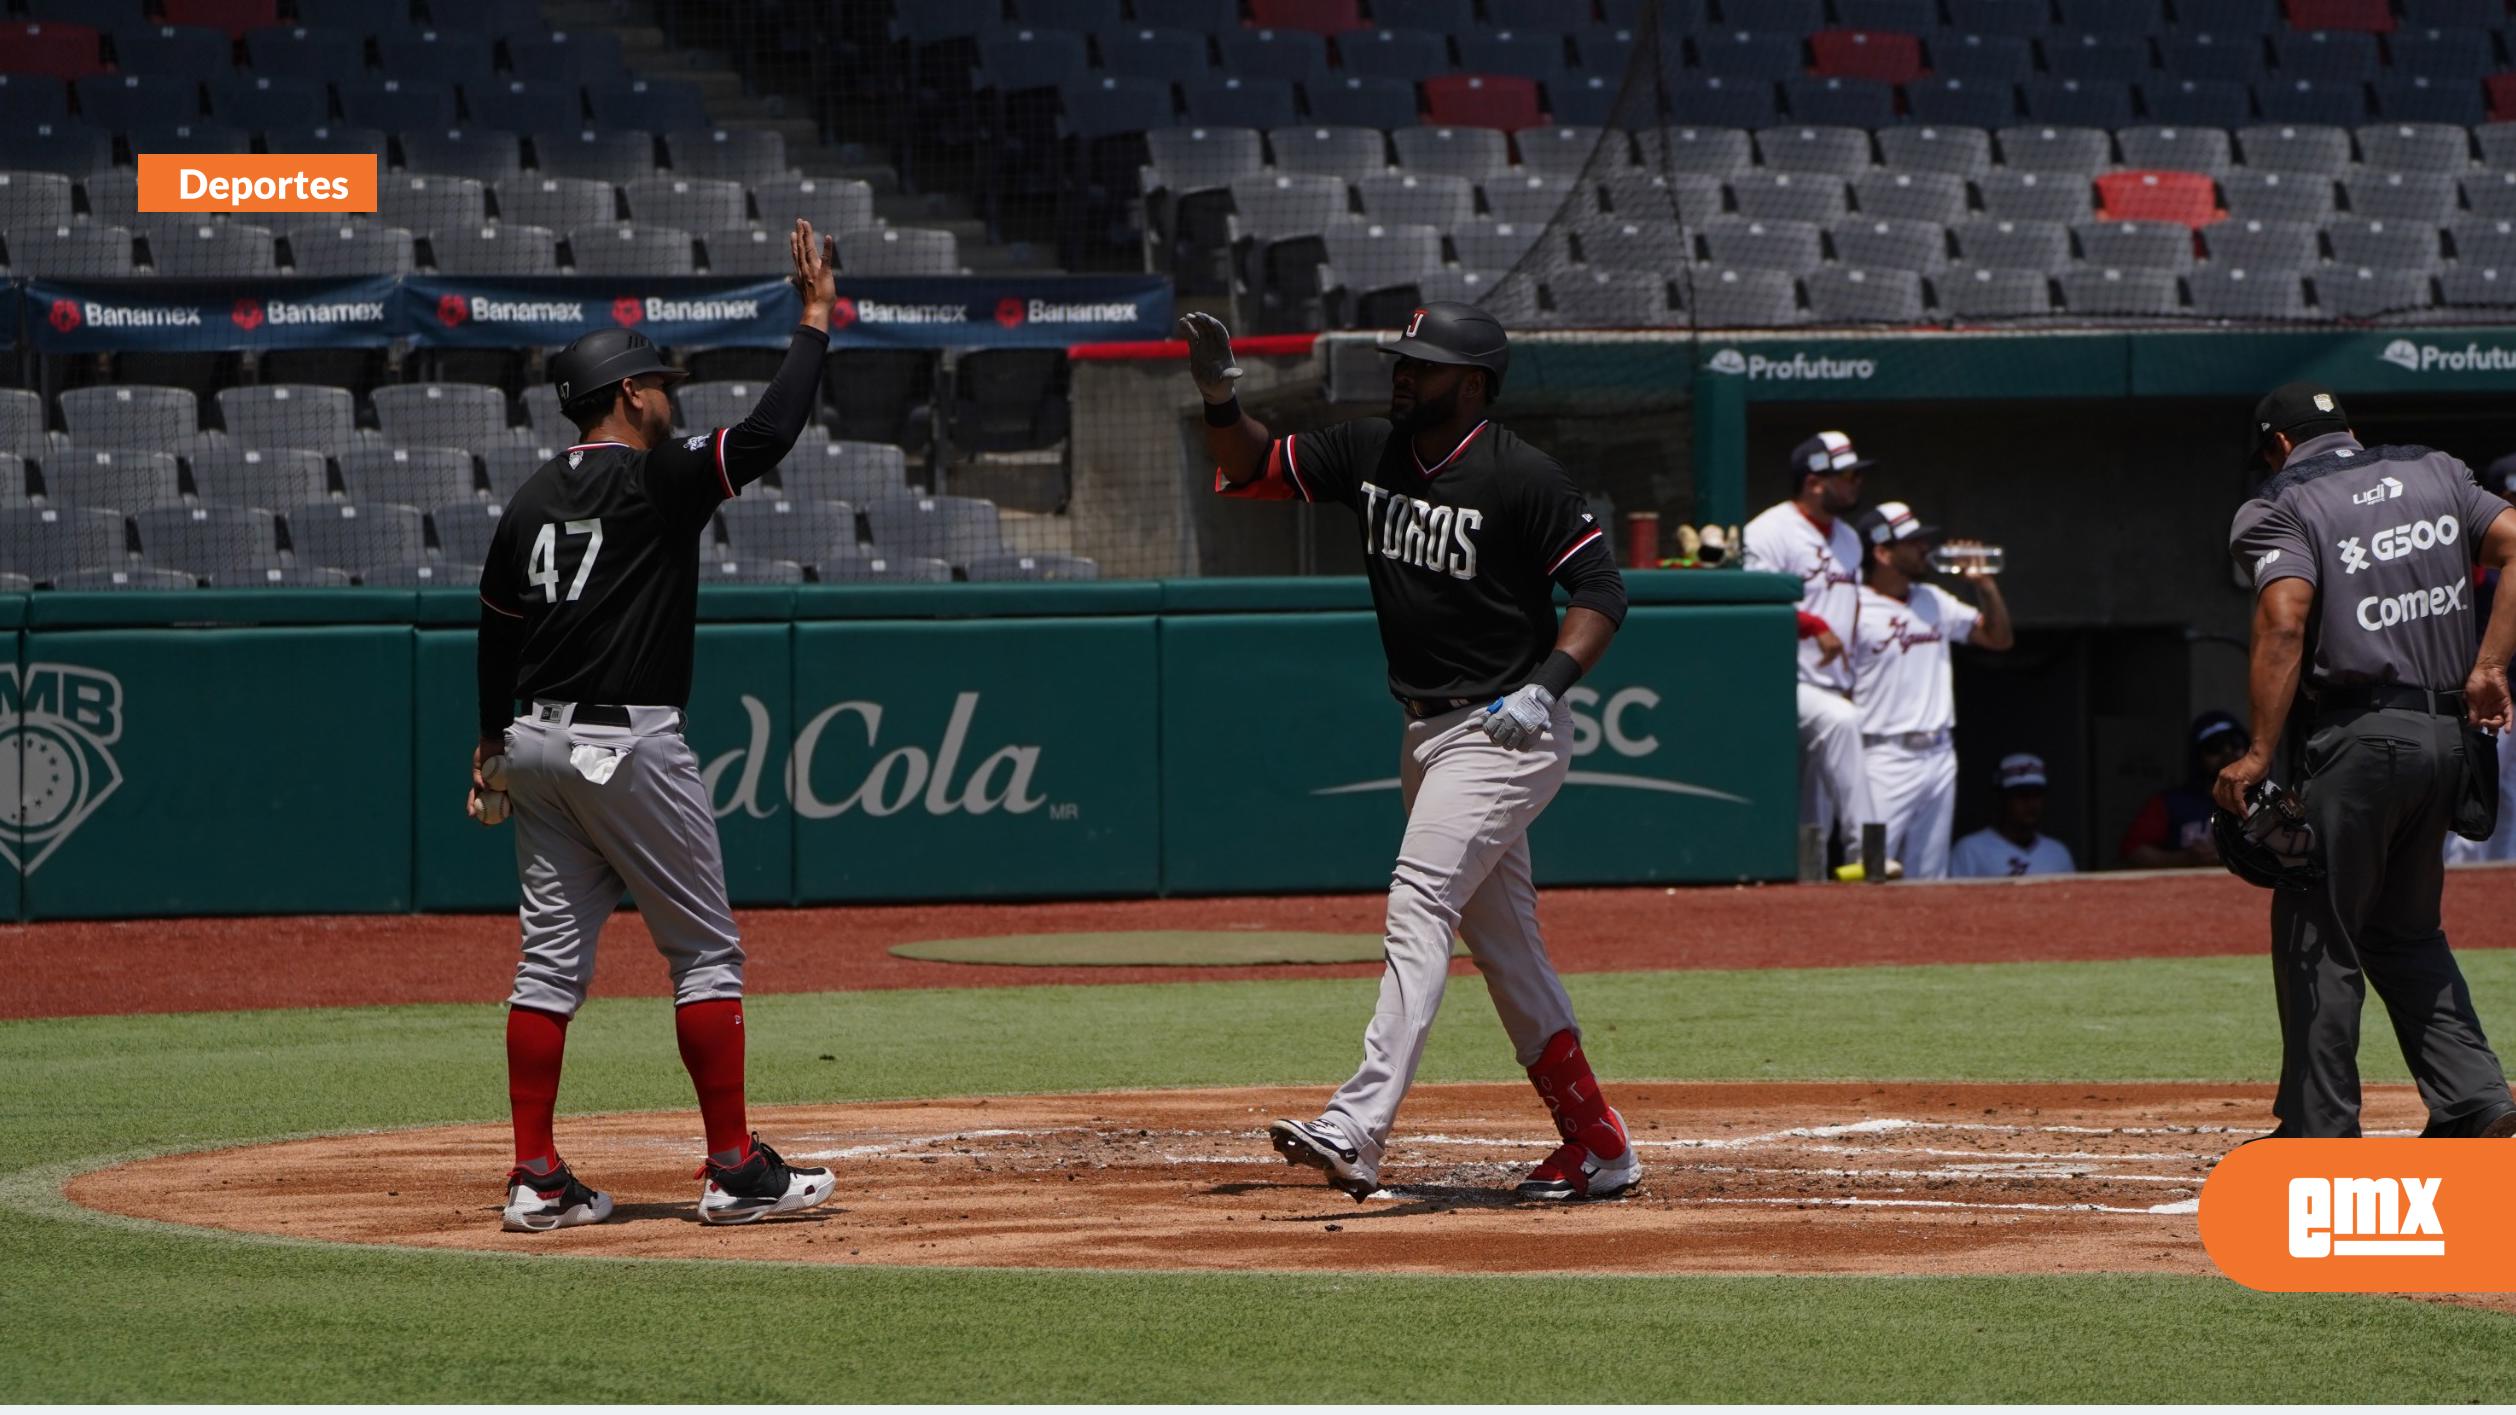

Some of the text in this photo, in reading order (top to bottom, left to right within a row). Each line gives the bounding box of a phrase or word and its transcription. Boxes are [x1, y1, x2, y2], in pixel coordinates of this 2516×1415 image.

[85, 303, 201, 328] Banamex
[267, 301, 384, 325] Banamex
[471, 297, 583, 322] Banamex
[645, 297, 758, 321] Banamex
[858, 301, 967, 324] Banamex
[1028, 300, 1138, 322] Banamex
[1749, 353, 1874, 379] Profuturo
[2353, 484, 2384, 504] udi
[1361, 481, 1483, 580] TOROS
[2371, 515, 2459, 561] G500
[528, 518, 603, 603] 47
[785, 692, 1047, 819] Cola
